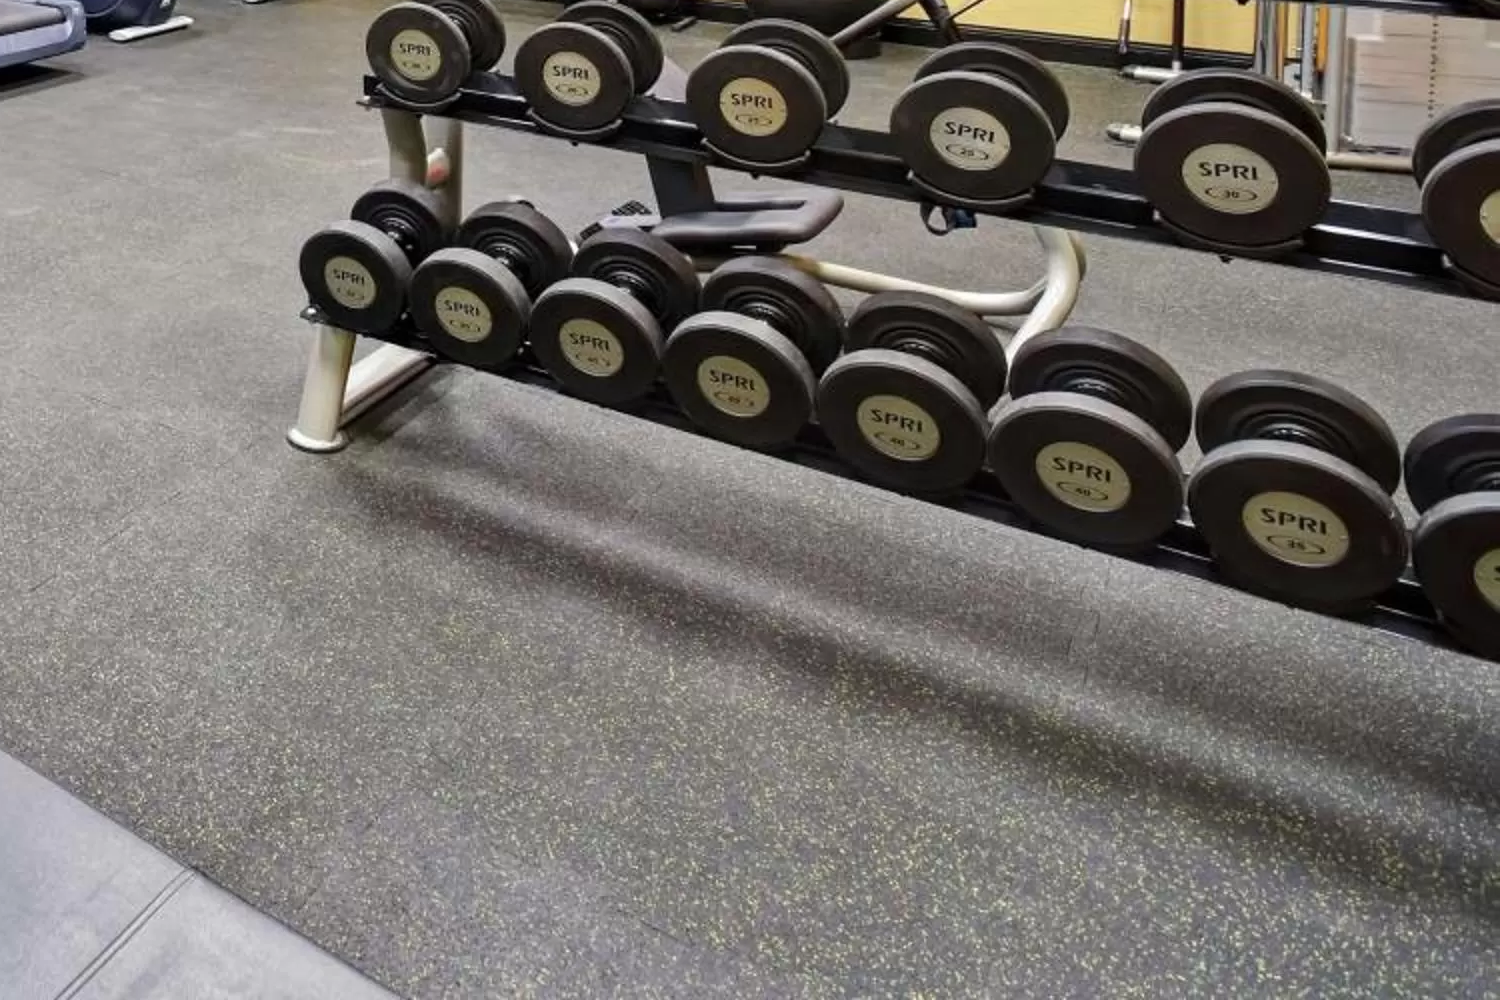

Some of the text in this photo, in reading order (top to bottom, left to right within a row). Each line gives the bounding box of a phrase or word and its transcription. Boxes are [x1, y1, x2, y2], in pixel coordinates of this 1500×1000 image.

[399, 43, 431, 57] SPRI
[552, 65, 589, 80] SPRI
[731, 93, 773, 109] SPRI
[944, 121, 995, 143] SPRI
[1198, 161, 1258, 181] SPRI
[332, 269, 364, 285] SPRI
[443, 299, 480, 317] SPRI
[569, 332, 610, 352] SPRI
[709, 369, 755, 391] SPRI
[870, 409, 922, 433] SPRI
[1051, 457, 1110, 483] SPRI
[1260, 507, 1328, 536] SPRI
